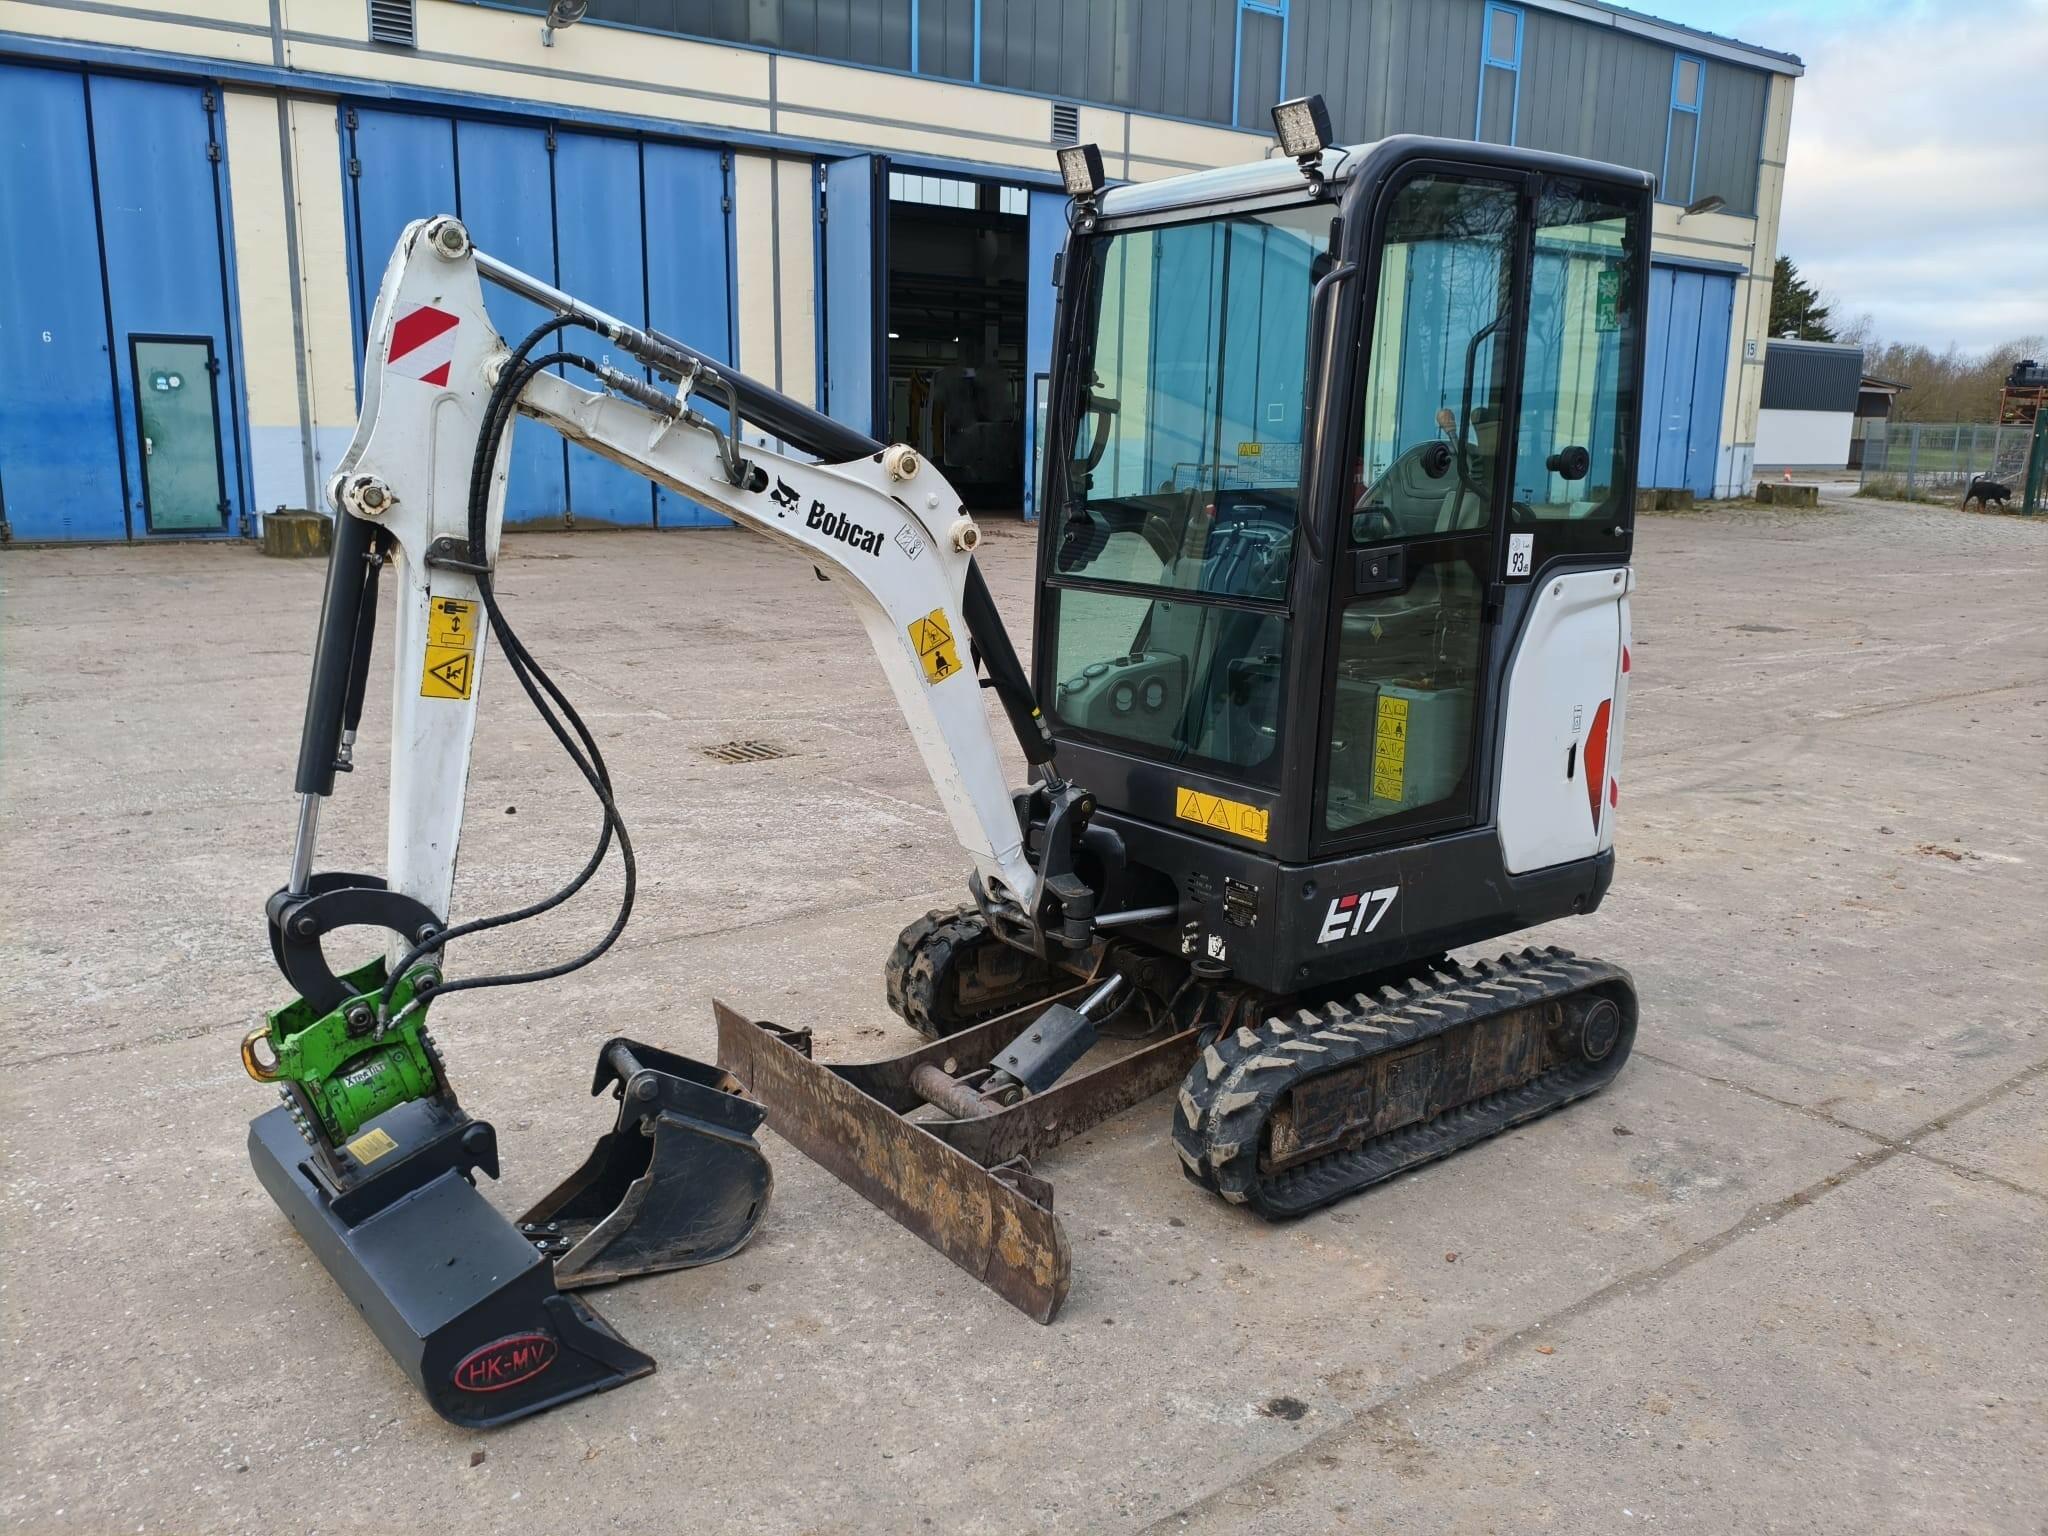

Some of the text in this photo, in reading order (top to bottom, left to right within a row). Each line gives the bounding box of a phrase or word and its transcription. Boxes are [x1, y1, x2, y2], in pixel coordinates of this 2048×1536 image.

[43, 331, 52, 343] 6
[602, 354, 610, 364] 5
[1747, 343, 1755, 356] 15
[806, 499, 885, 557] Bobcat
[1512, 552, 1524, 572] 93
[1317, 886, 1399, 944] E17
[469, 1343, 545, 1385] HK-MV
